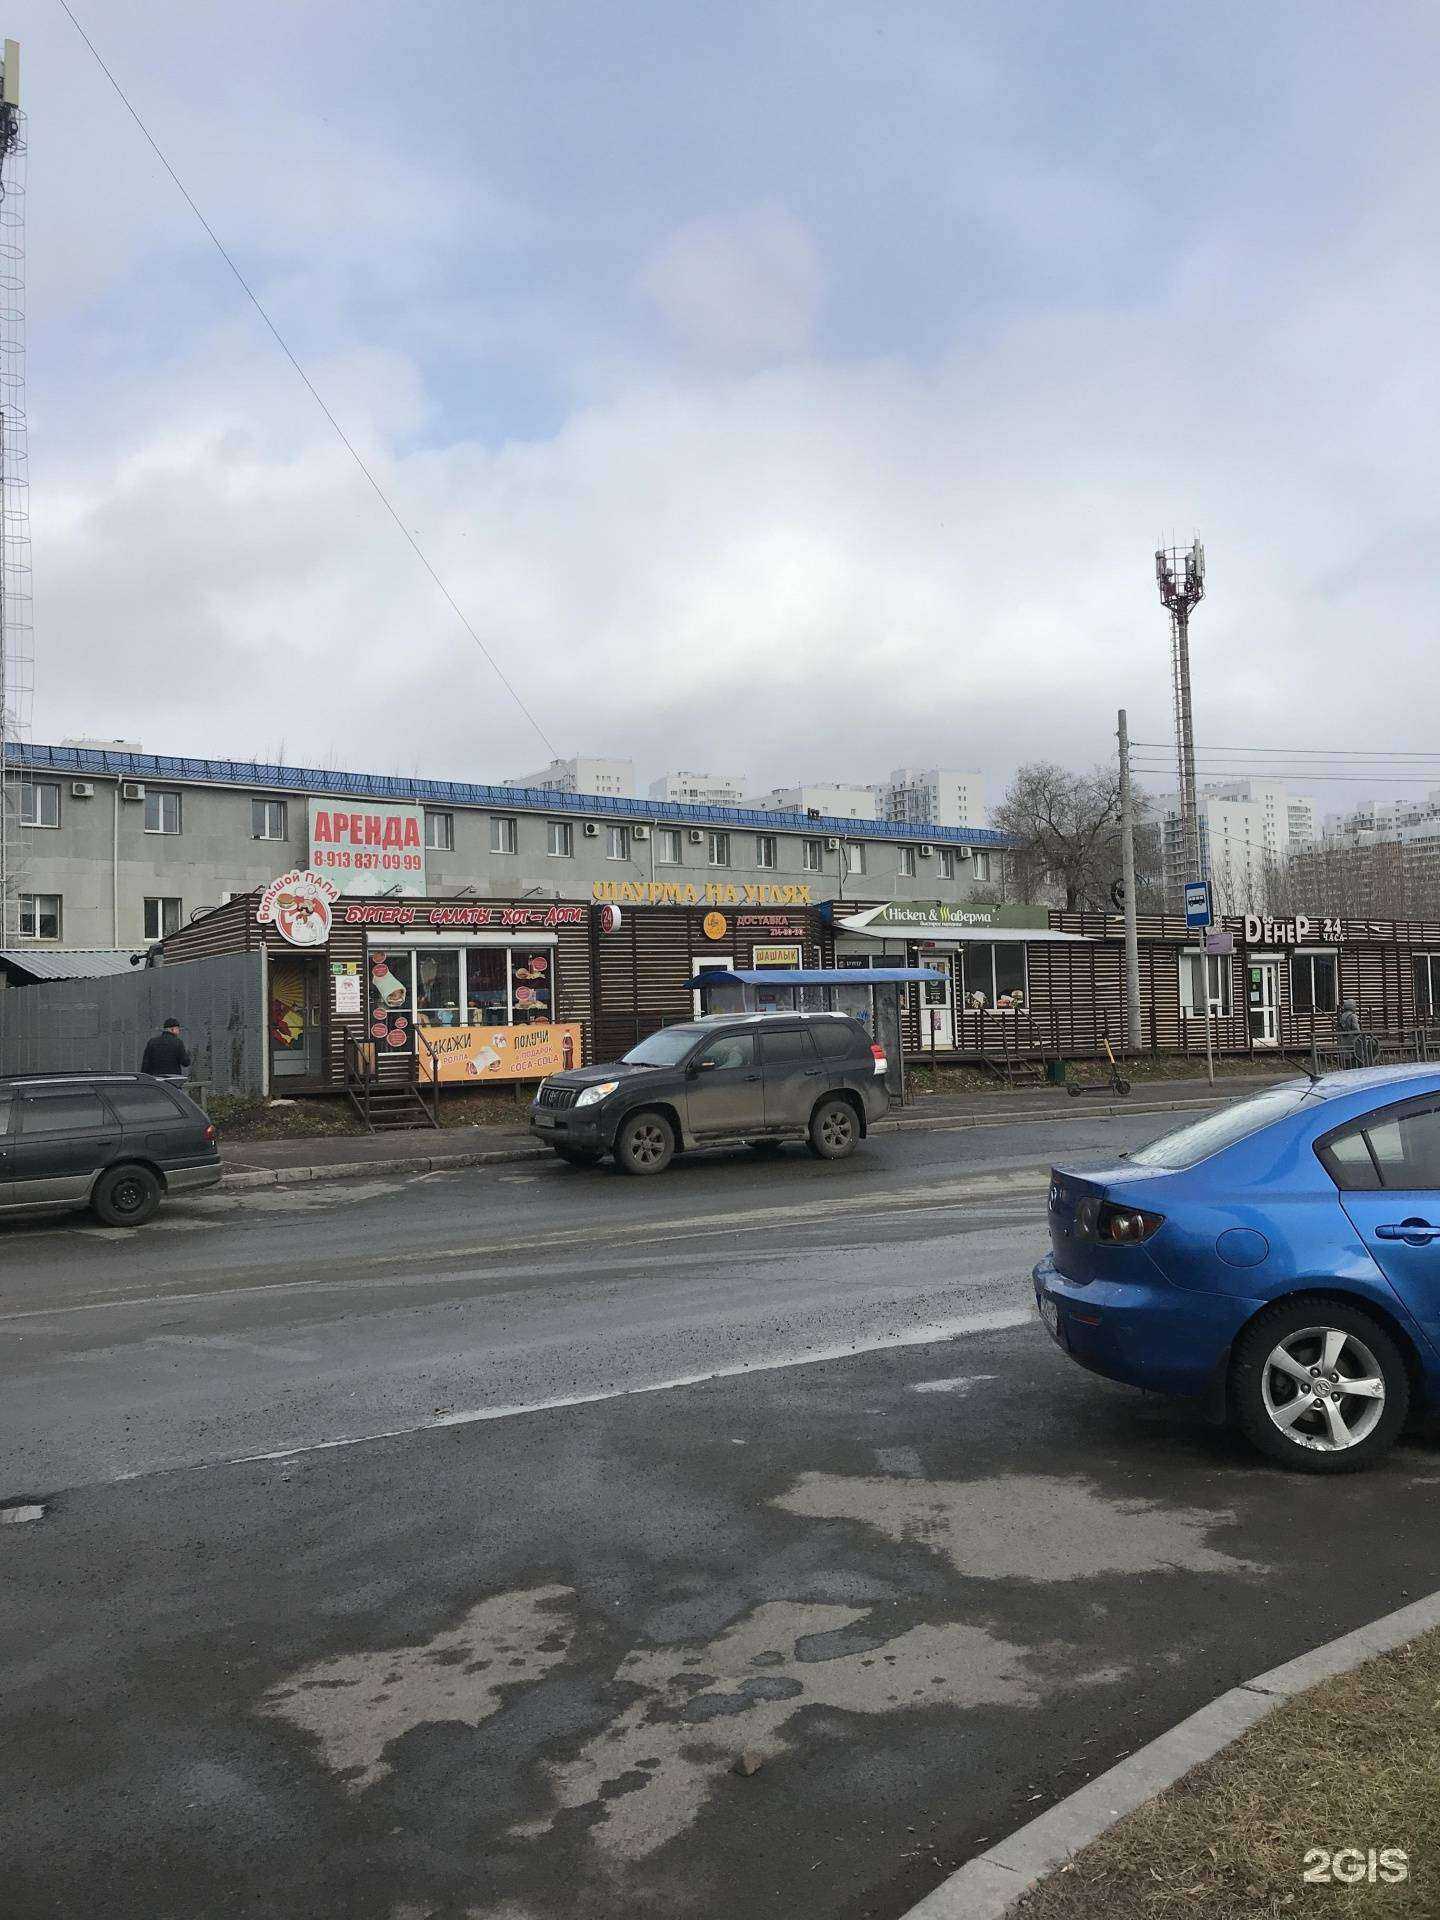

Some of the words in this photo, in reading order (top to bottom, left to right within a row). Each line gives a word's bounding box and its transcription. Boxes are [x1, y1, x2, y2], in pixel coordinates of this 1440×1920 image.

[314, 811, 421, 851] АРЕНДА
[305, 872, 338, 900] ПАПА
[592, 880, 698, 901] ШАУРМА
[704, 882, 740, 901] НА
[742, 884, 812, 902] УГЛЯХ
[345, 906, 416, 923] БУРГЕРЫ
[430, 907, 492, 924] САЛАТЫ
[736, 915, 789, 926] ДОСТАВКА
[929, 909, 938, 921] &
[1323, 918, 1342, 934] 24
[1323, 933, 1345, 942] ЧАСА
[756, 950, 796, 961] ШАШЛЫК
[426, 1033, 472, 1057] ЗАКАЖИ
[514, 1029, 549, 1050] ПОЛУЧИ
